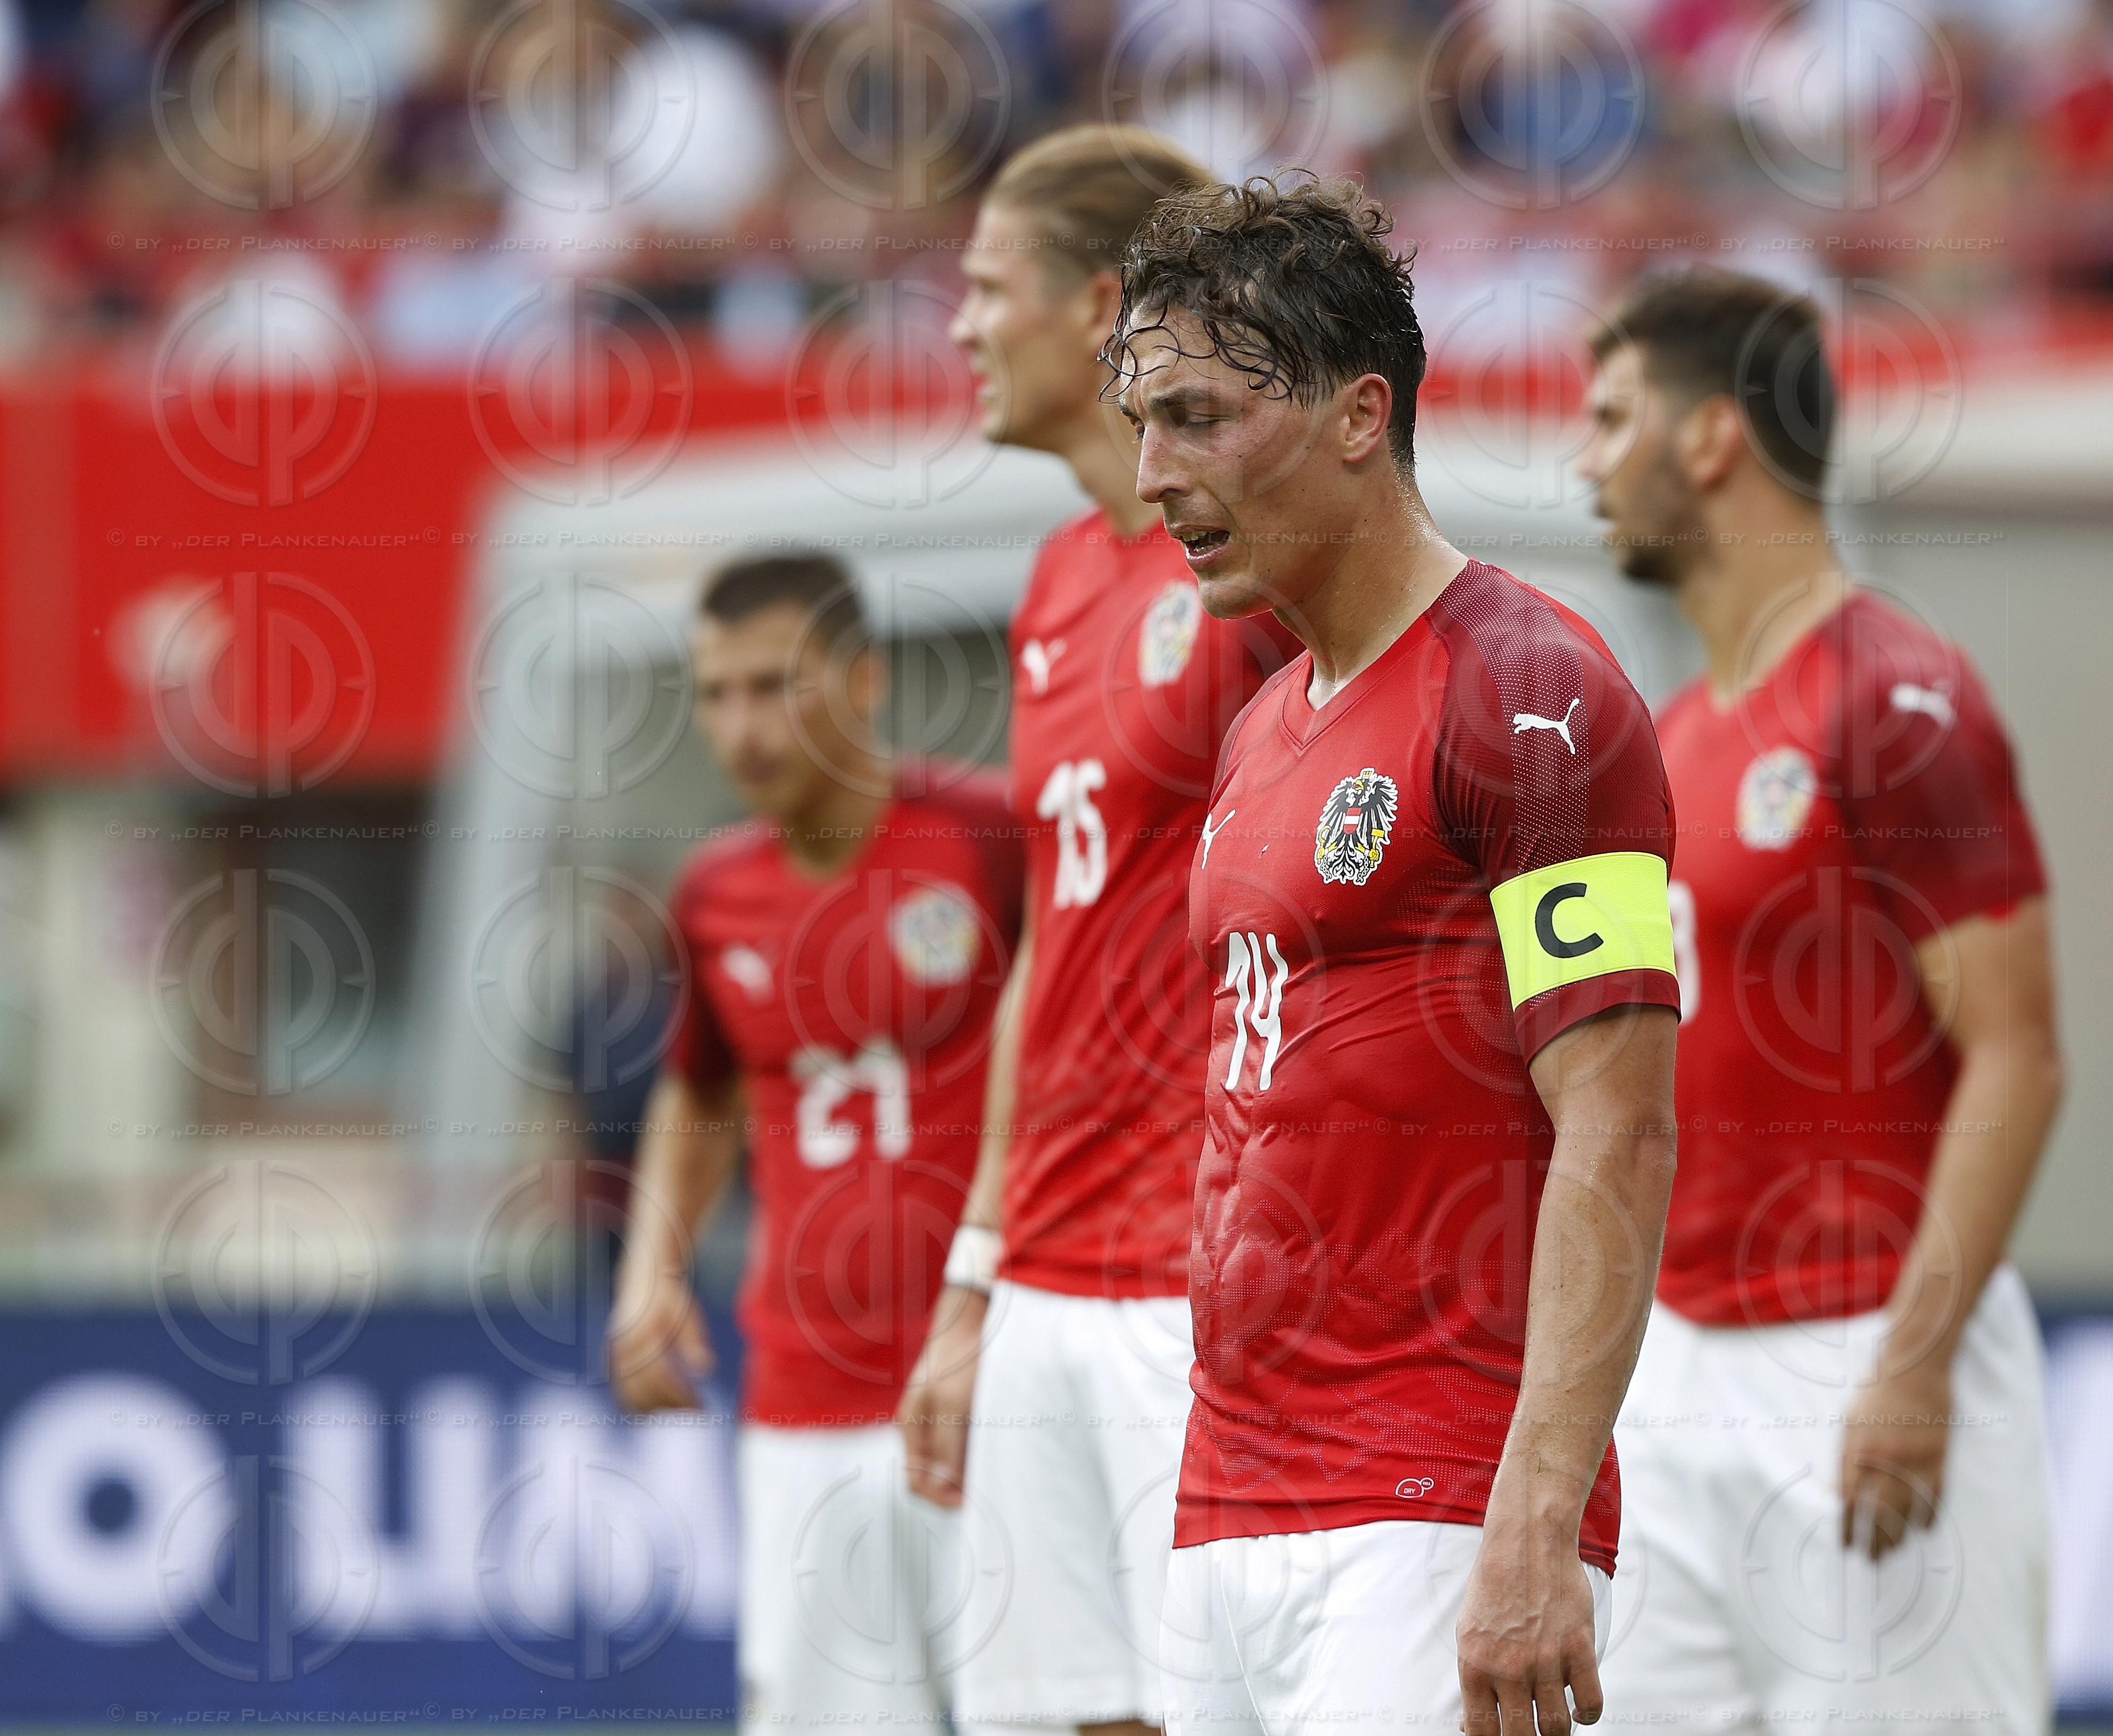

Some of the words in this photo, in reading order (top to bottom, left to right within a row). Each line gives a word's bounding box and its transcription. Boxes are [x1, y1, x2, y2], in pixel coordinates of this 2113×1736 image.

[1036, 758, 1108, 908] 15
[1535, 882, 1603, 958] C
[1225, 932, 1289, 1091] 14
